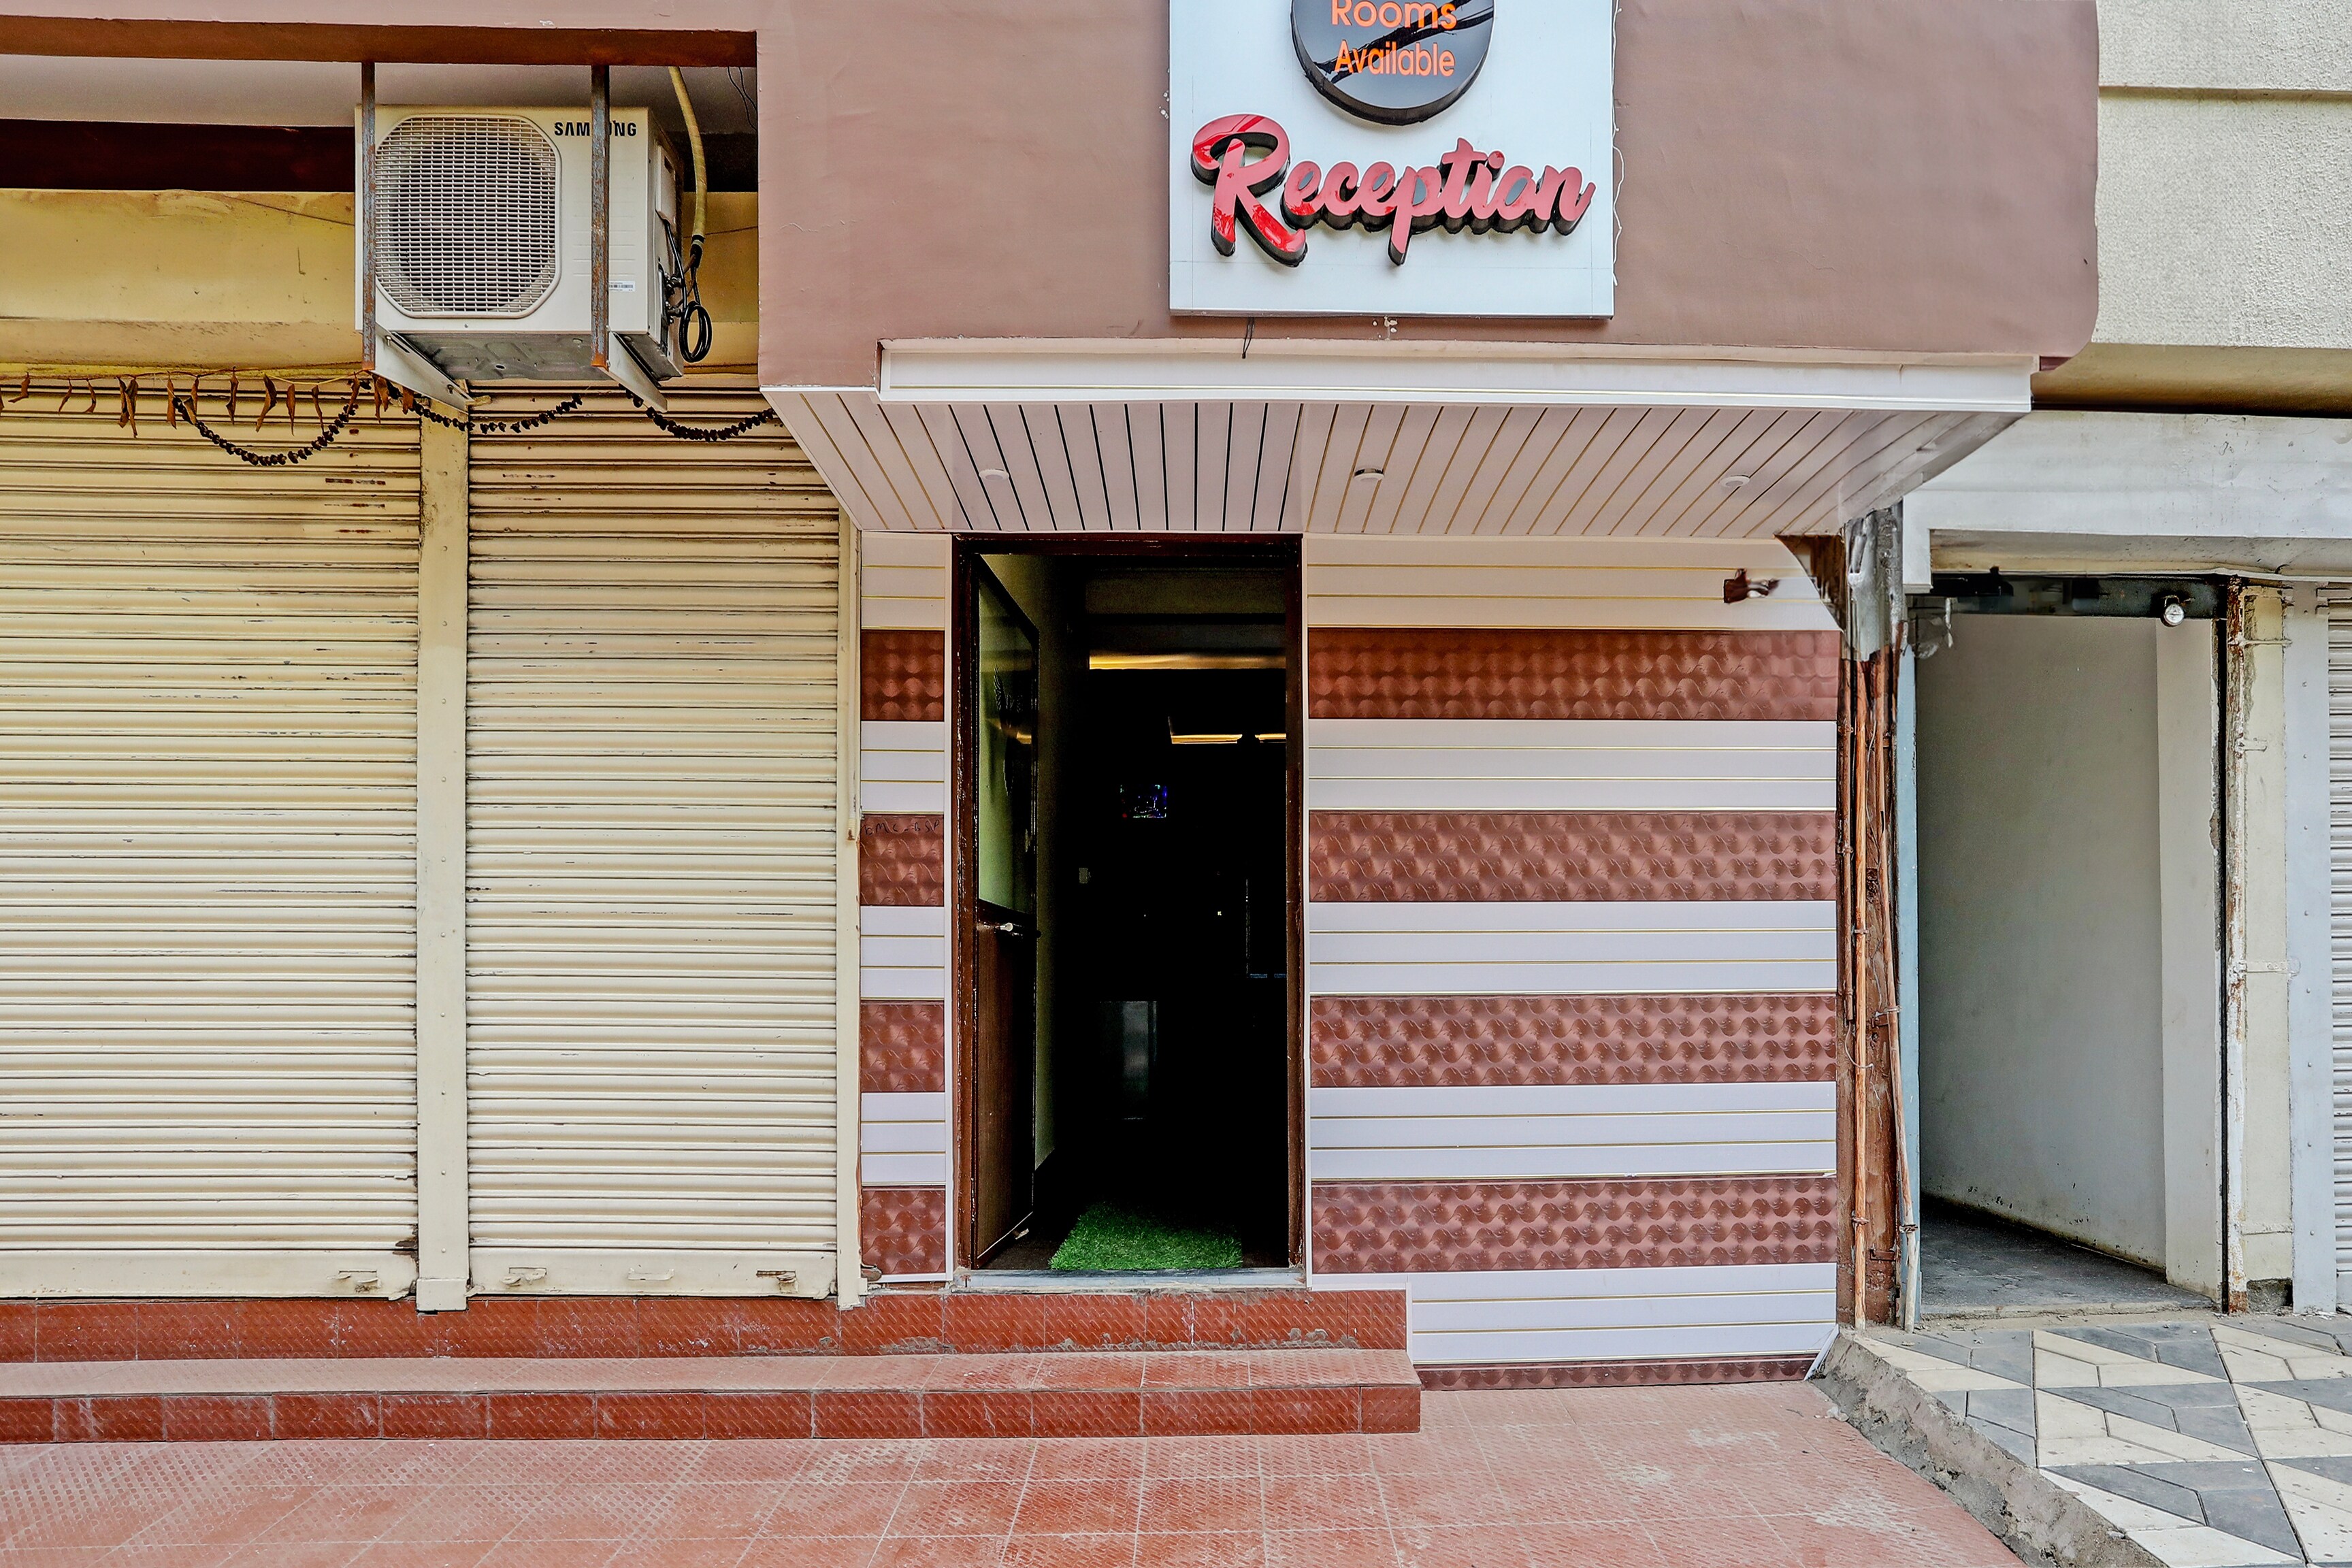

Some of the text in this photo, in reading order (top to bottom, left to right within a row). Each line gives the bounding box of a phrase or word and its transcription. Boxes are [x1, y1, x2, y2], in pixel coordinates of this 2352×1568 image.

[1331, 0, 1457, 29] Rooms
[1334, 39, 1456, 77] Available
[555, 122, 637, 136] SAMNG
[1192, 114, 1595, 267] Reception
